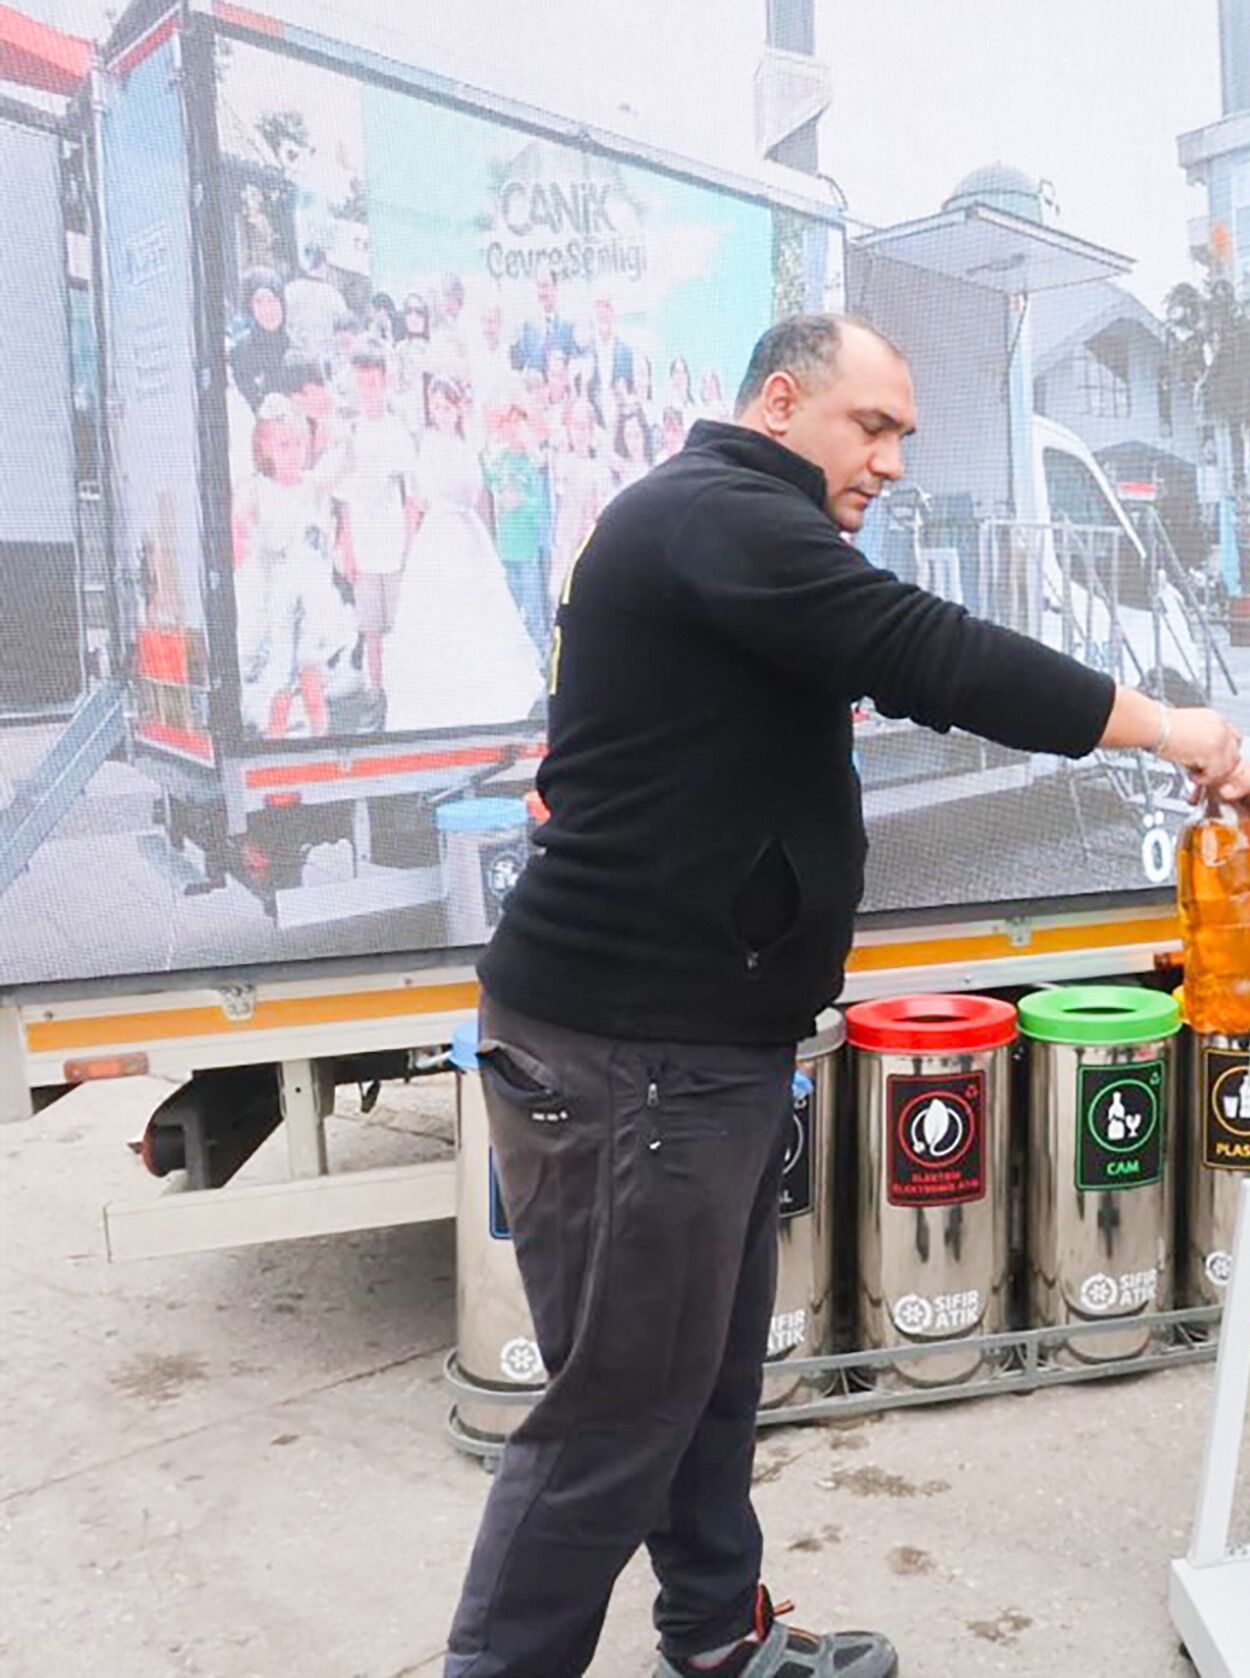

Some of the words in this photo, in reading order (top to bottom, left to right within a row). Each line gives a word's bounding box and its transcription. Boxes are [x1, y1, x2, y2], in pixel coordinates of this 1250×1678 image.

[1106, 1160, 1140, 1176] CAM
[1120, 1268, 1158, 1291] SIFIR
[934, 1289, 980, 1313] SIFIR
[769, 1310, 806, 1332] IFIR
[933, 1307, 980, 1330] ATIK
